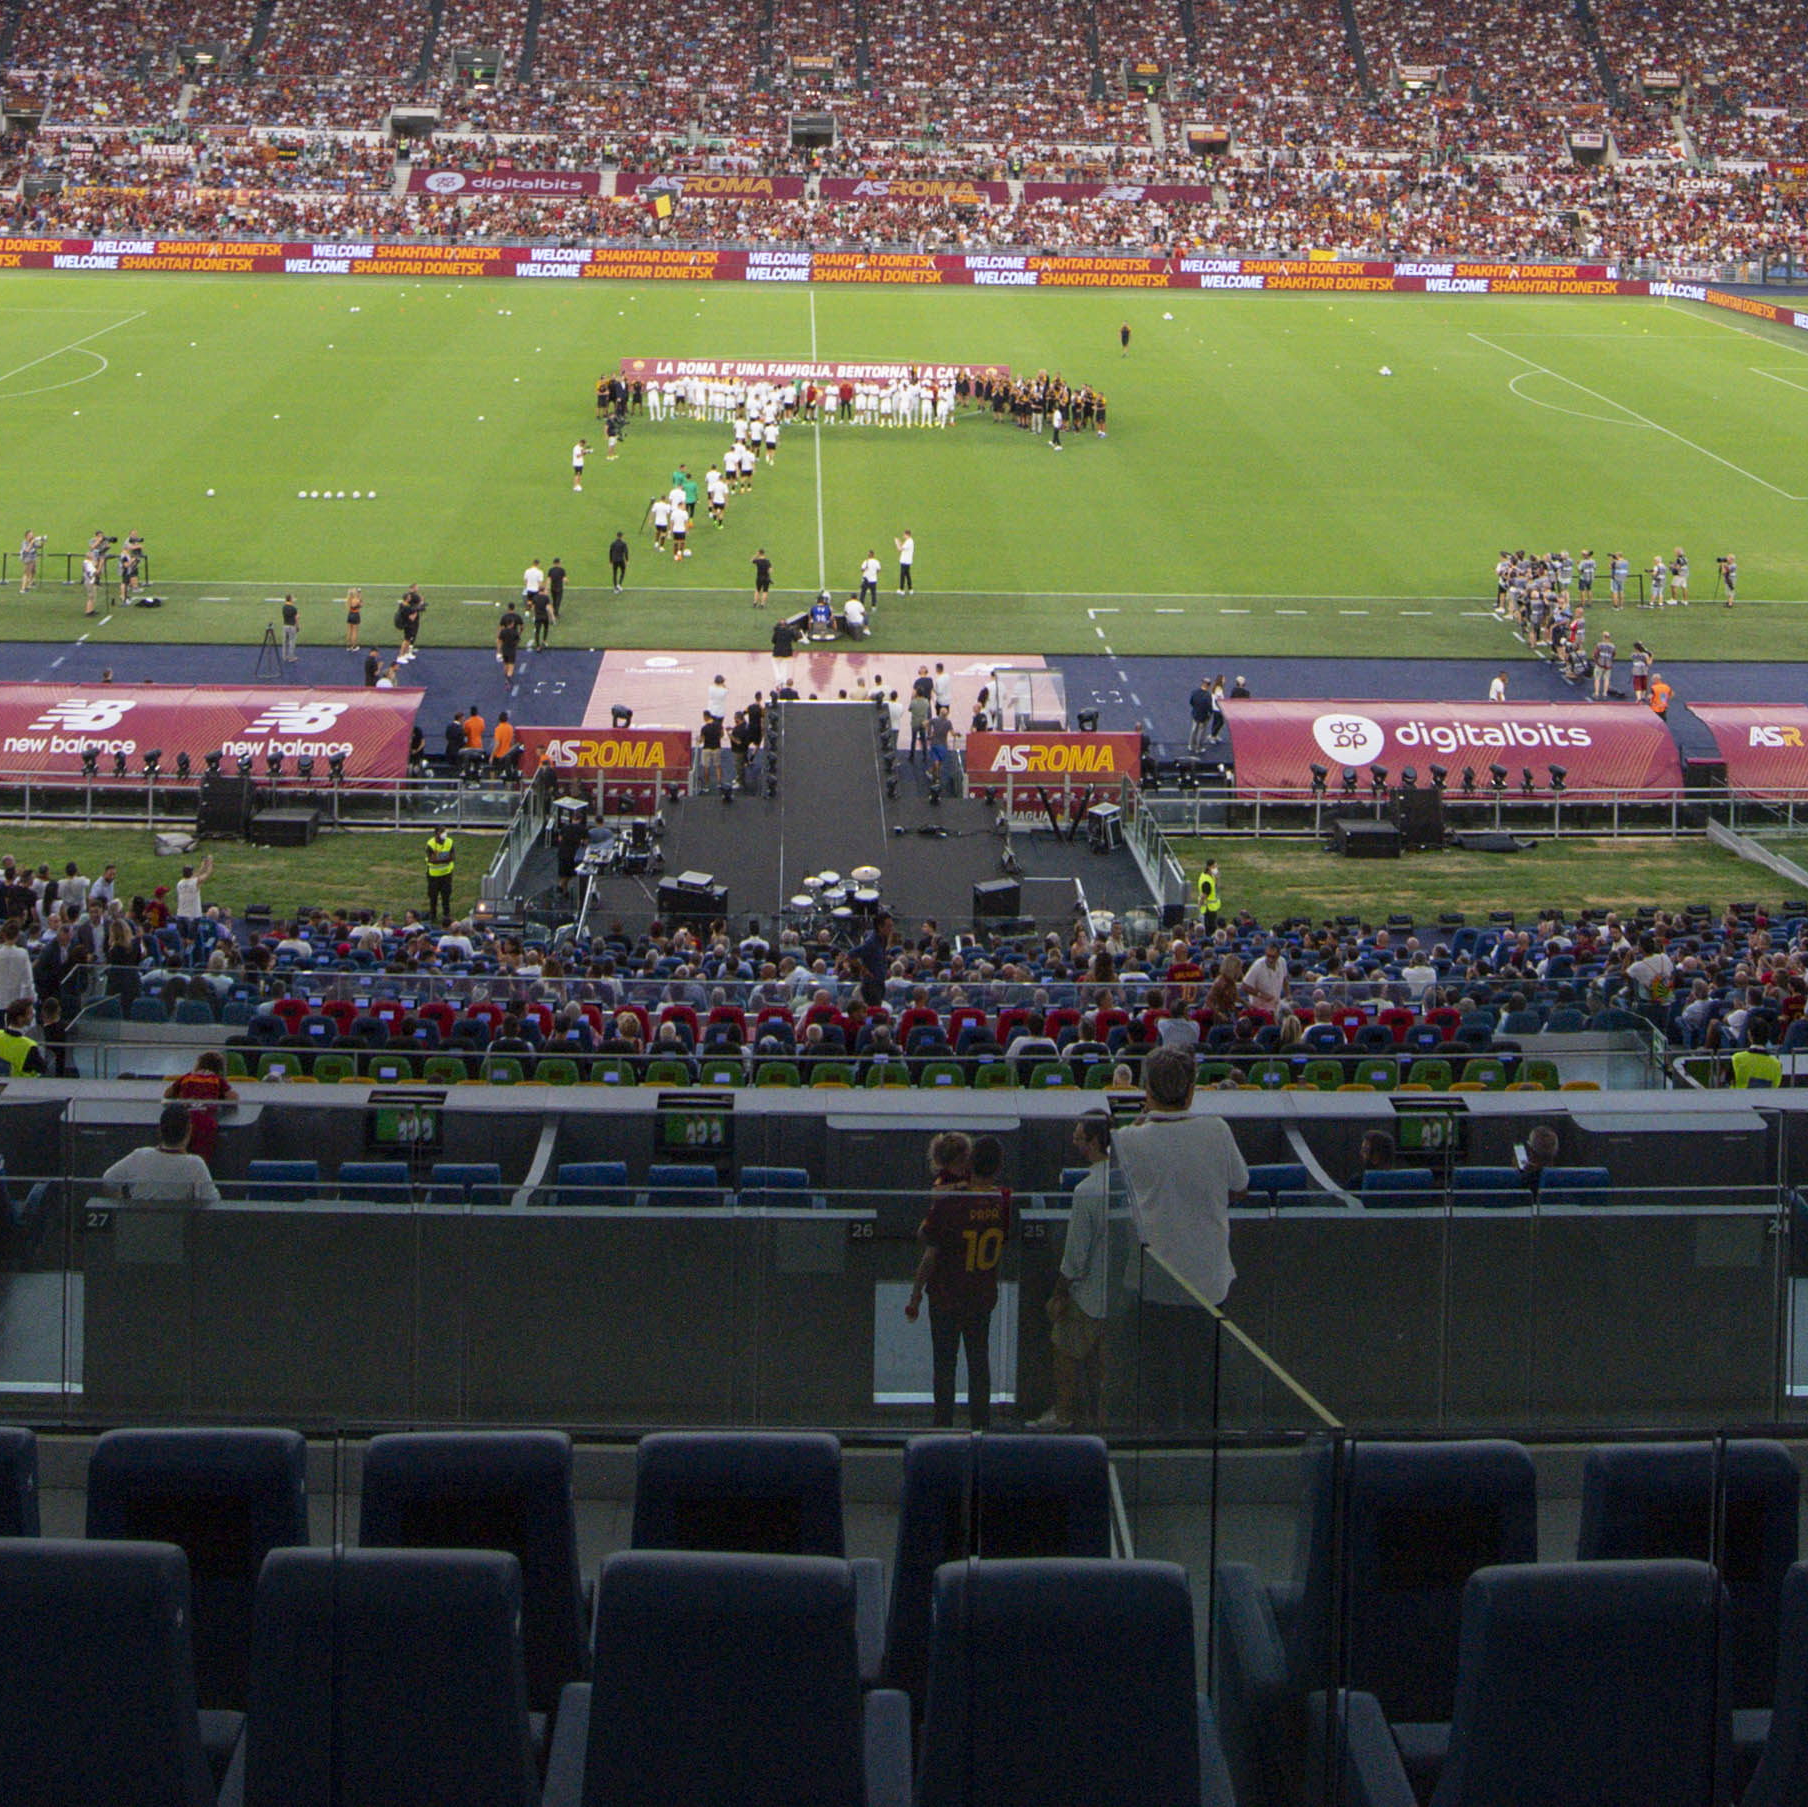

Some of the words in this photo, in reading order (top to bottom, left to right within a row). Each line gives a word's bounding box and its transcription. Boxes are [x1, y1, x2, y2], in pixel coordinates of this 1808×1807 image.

[471, 176, 583, 190] digitalbits
[5, 239, 62, 252] DONETSK
[92, 241, 154, 254] WELCOME
[225, 243, 282, 256] DONETSK
[312, 245, 374, 258] WELCOME
[377, 245, 445, 260] SHAKHTAR
[53, 255, 118, 269] WELCOME
[121, 257, 191, 271] SHAKHTAR
[193, 258, 254, 271] DONETSK
[531, 248, 593, 262] WELCOME
[595, 250, 660, 263] SHAKHTAR
[748, 253, 810, 266] WELCOME
[965, 256, 1026, 270] WELCOME
[1095, 258, 1151, 271] DONETSK
[284, 259, 350, 273] WELCOME
[353, 260, 422, 274] SHAKHTAR
[424, 261, 484, 275] DONETSK
[515, 263, 580, 277] WELCOME
[583, 265, 653, 278] SHAKHTAR
[655, 266, 714, 279] DONETSK
[745, 267, 809, 281] WELCOME
[812, 268, 881, 282] SHAKHTAR
[882, 269, 942, 283] DONETSK
[1180, 259, 1241, 273] WELCOME
[1308, 262, 1364, 275] DONETSK
[1394, 263, 1454, 276] WELCOME
[1521, 266, 1577, 279] DONETSK
[974, 271, 1038, 285] WELCOME
[1040, 272, 1110, 286] SHAKHTAR
[1112, 273, 1171, 287] DONETSK
[1200, 275, 1264, 289] WELCOME
[1266, 276, 1335, 290] SHAKHTAR
[1336, 277, 1394, 291] DONETSK
[1425, 279, 1489, 293] WELCOME
[1490, 280, 1559, 294] SHAKHTAR
[1561, 281, 1618, 294] DONETSK
[656, 362, 673, 374] LA
[676, 362, 716, 375] ROMA
[736, 363, 765, 376] UNA
[767, 364, 833, 377] FAMIGLIA.
[1395, 721, 1592, 754] digitalbits
[1749, 726, 1805, 747] ASR
[4, 737, 46, 753] new
[50, 735, 137, 756] balance
[222, 741, 264, 756] new
[268, 738, 353, 758] balance
[545, 740, 666, 768] ASROMA
[990, 745, 1115, 772] ASROMA
[88, 1213, 109, 1227] 27
[852, 1224, 874, 1238] 26
[1024, 1225, 1045, 1238] 25
[962, 1227, 1005, 1273] 10
